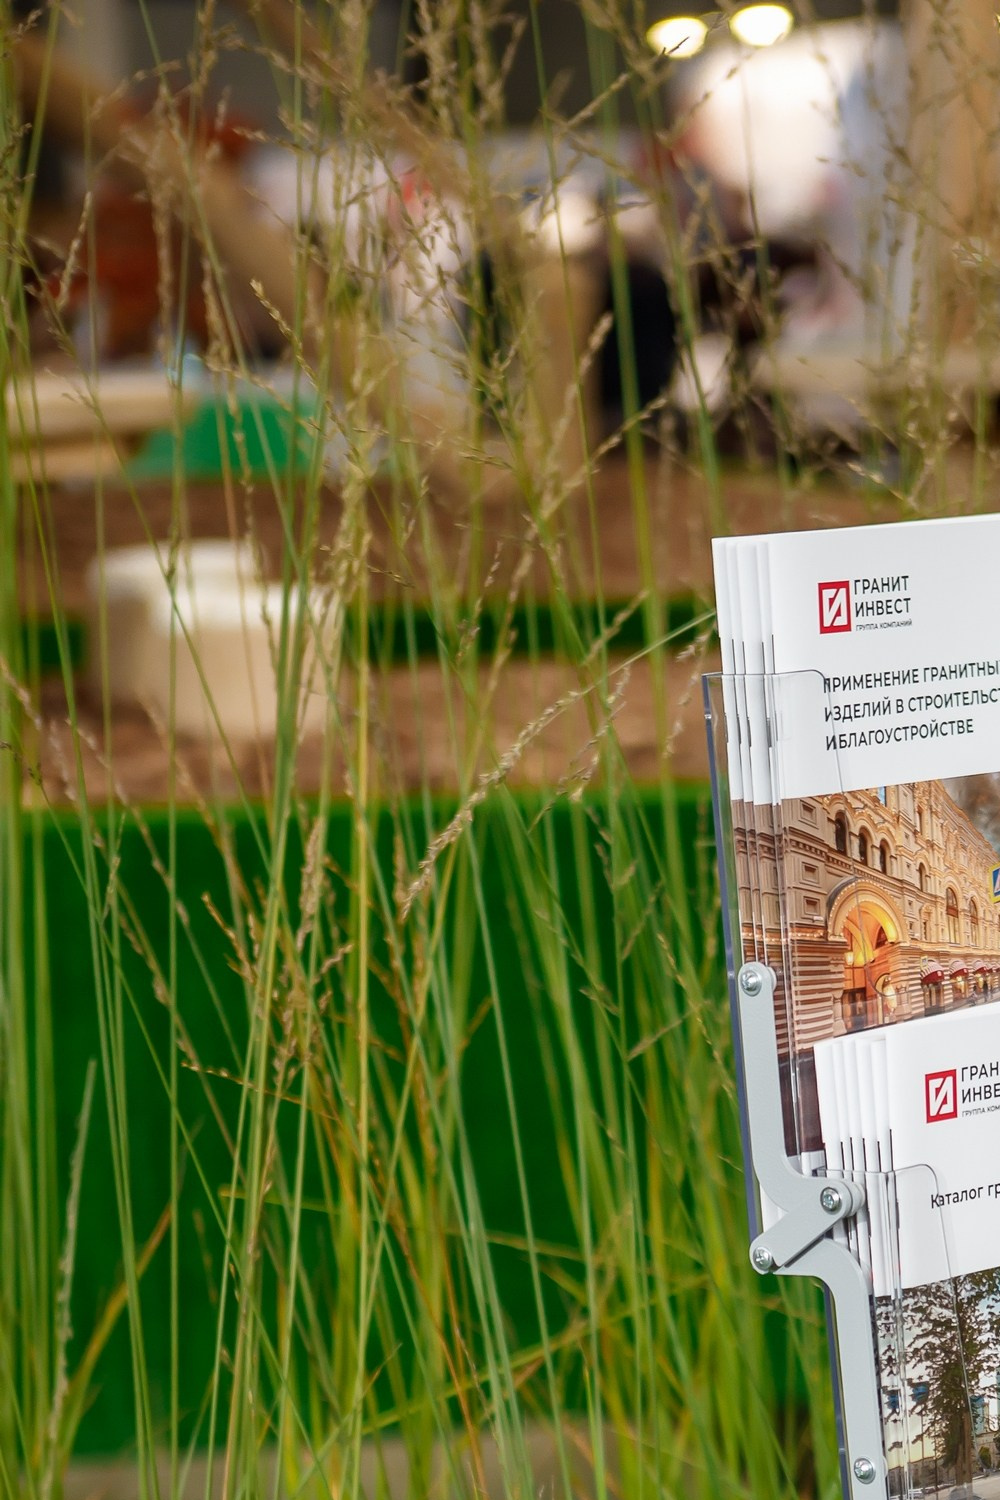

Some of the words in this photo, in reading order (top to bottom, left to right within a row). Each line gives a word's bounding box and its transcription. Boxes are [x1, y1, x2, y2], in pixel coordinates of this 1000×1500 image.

[854, 575, 909, 595] ГРАНИТ
[855, 597, 911, 617] ИНВЕСТ
[824, 668, 919, 693] ПРИМЕНЕНИЕ
[824, 696, 891, 723] ИЗДЕЛИЙ
[896, 698, 904, 714] В
[930, 1185, 983, 1208] Каталог
